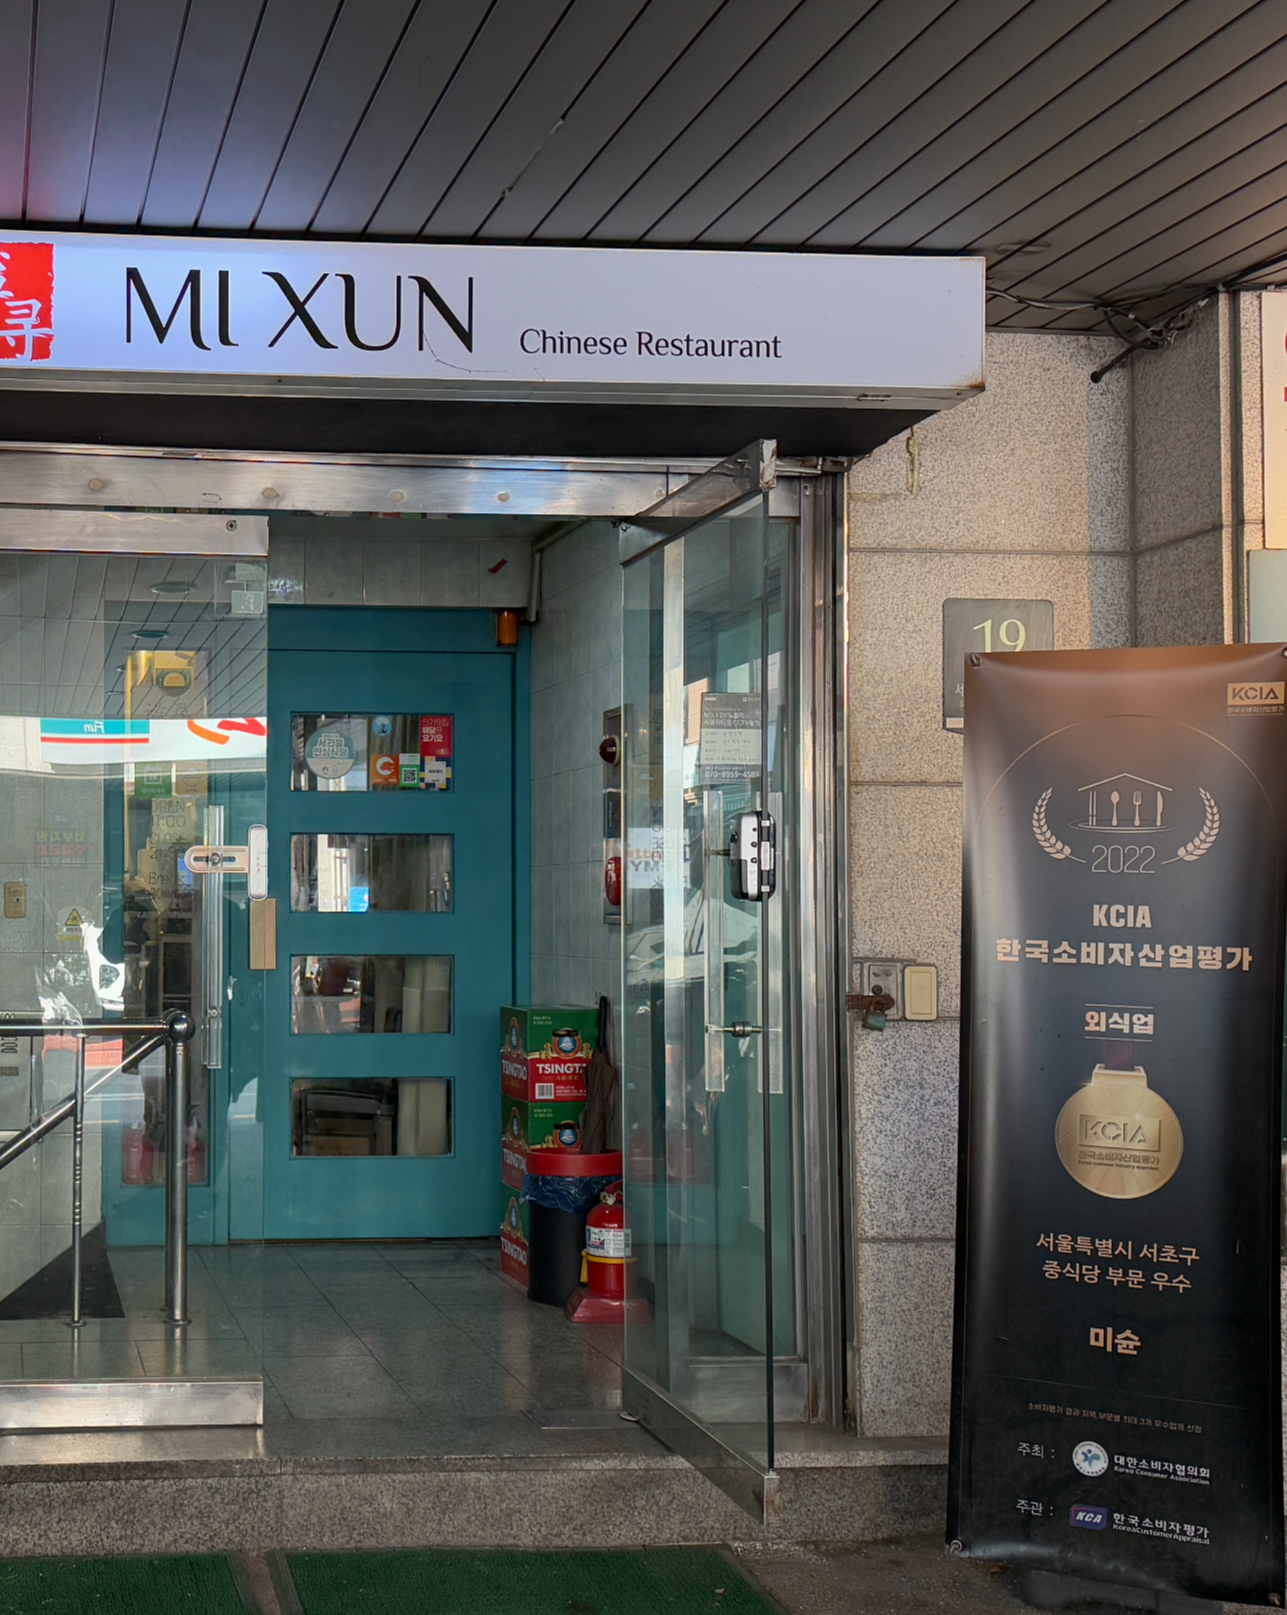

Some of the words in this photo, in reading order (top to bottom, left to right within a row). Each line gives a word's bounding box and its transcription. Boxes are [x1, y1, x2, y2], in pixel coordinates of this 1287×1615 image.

[126, 267, 239, 351] MI
[262, 271, 474, 353] XUN
[519, 328, 628, 355] Chinese
[635, 330, 783, 358] Restaurant
[973, 619, 1026, 653] 19
[1232, 686, 1279, 701] KCIA
[1091, 844, 1156, 874] 2022
[1092, 904, 1152, 928] KCIA
[996, 938, 1253, 971] 한국소비자산업평가
[1084, 1010, 1155, 1036] 외식업
[501, 1060, 528, 1080] TSINGTAO
[536, 1063, 587, 1074] TSINGT
[1085, 1120, 1149, 1143] KCIA
[501, 1236, 527, 1265] TSINGTAO
[1036, 1232, 1133, 1260] 서울특별시
[1139, 1243, 1200, 1266] 서초구
[1042, 1260, 1101, 1284] 중식당
[1105, 1267, 1146, 1289] 부문
[1150, 1272, 1192, 1293] 우수
[1089, 1326, 1141, 1355] 미슌
[1028, 1402, 1063, 1414] 소비자평가
[1017, 1442, 1044, 1459] 주최
[1114, 1454, 1211, 1478] 대한소비자협의회
[1114, 1465, 1135, 1474] Korea
[1135, 1468, 1168, 1479] Consumer
[1169, 1473, 1210, 1485] Association
[1015, 1499, 1043, 1516] 주관
[1075, 1511, 1103, 1524] KCA
[1112, 1512, 1209, 1538] 한국소비자평가
